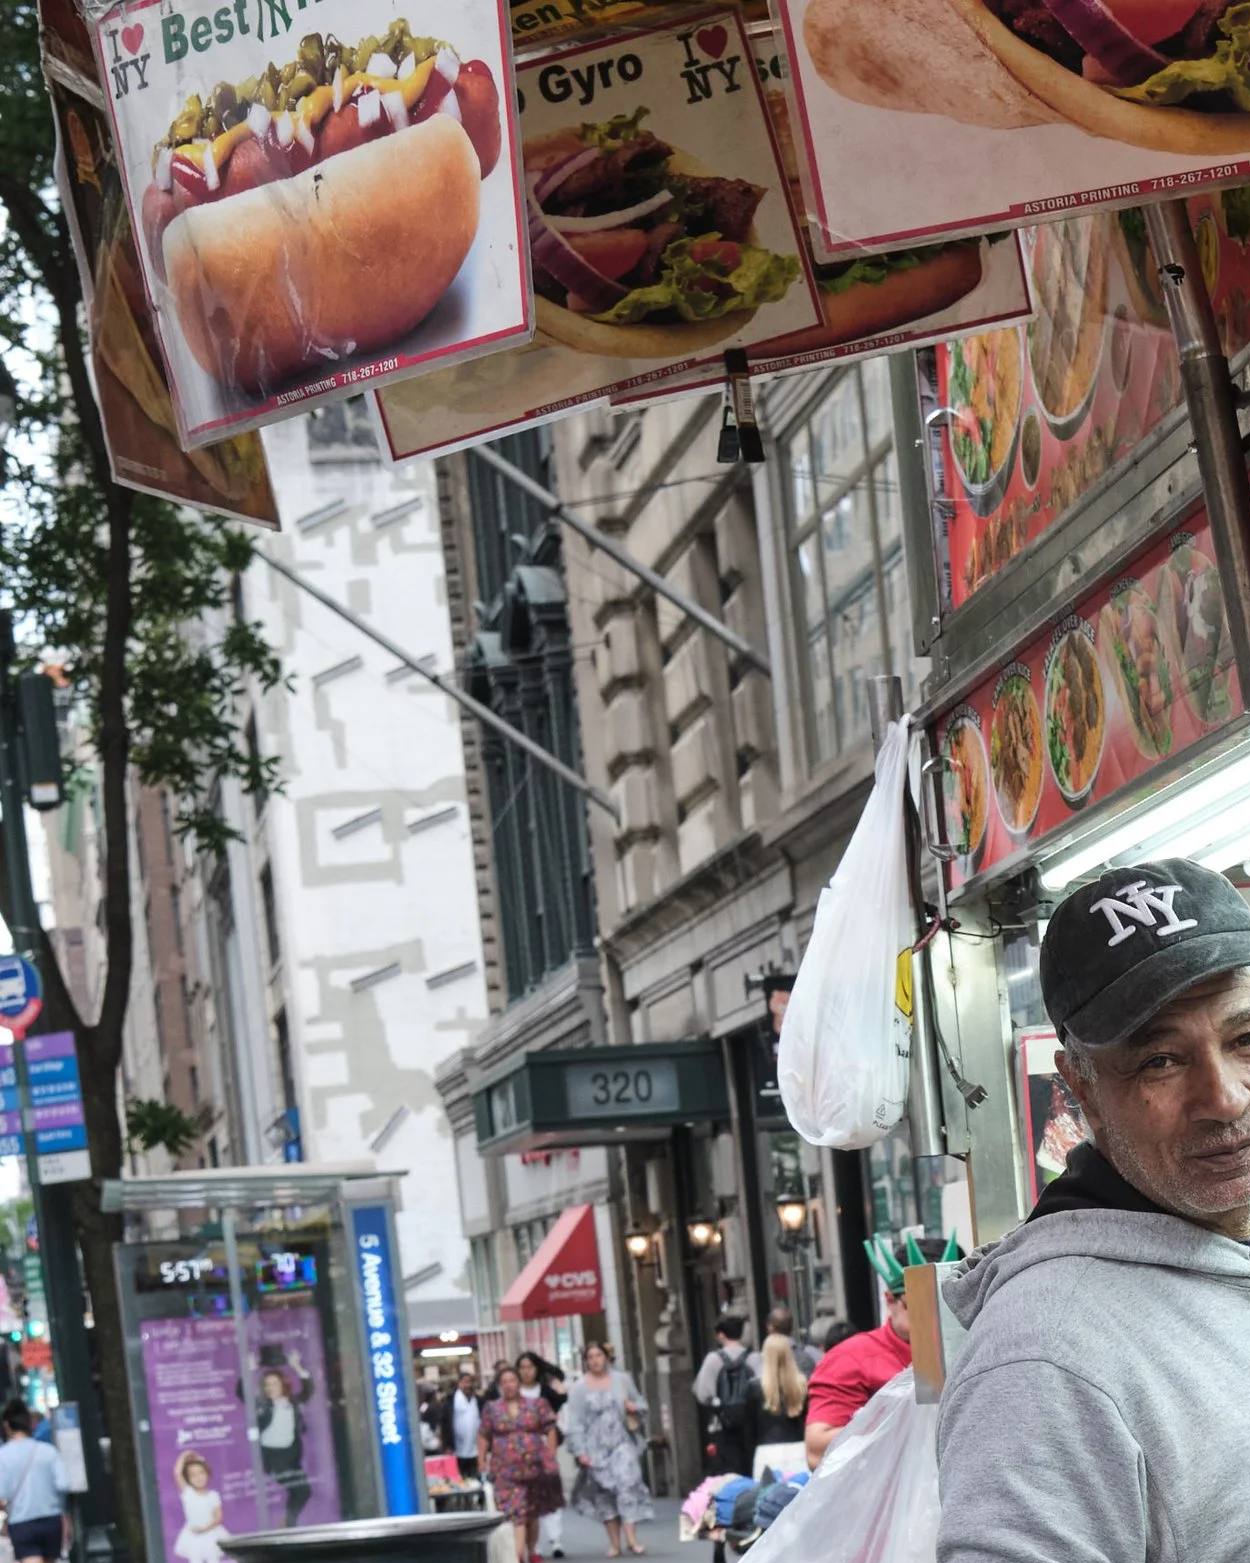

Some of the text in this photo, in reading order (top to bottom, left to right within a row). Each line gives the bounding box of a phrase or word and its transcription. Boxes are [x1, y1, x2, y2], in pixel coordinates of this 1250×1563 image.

[109, 30, 122, 64] I
[161, 0, 250, 64] Best
[676, 32, 700, 69] I
[111, 53, 151, 99] NY
[538, 53, 643, 105] Gyro
[680, 56, 742, 104] NY
[1024, 164, 1240, 214] ASTORIA PRINTING 718-267-1201
[276, 357, 399, 405] ASTORIA PRINTING 718-267-1201
[754, 358, 792, 375] ASTORIA
[793, 349, 836, 366] PRINTING
[535, 398, 574, 416] ASTORIA
[1090, 881, 1198, 946] NY
[591, 1069, 653, 1105] 320
[561, 1271, 597, 1289] CVS
[359, 1234, 402, 1445] 5 Avenue & 32 Street
